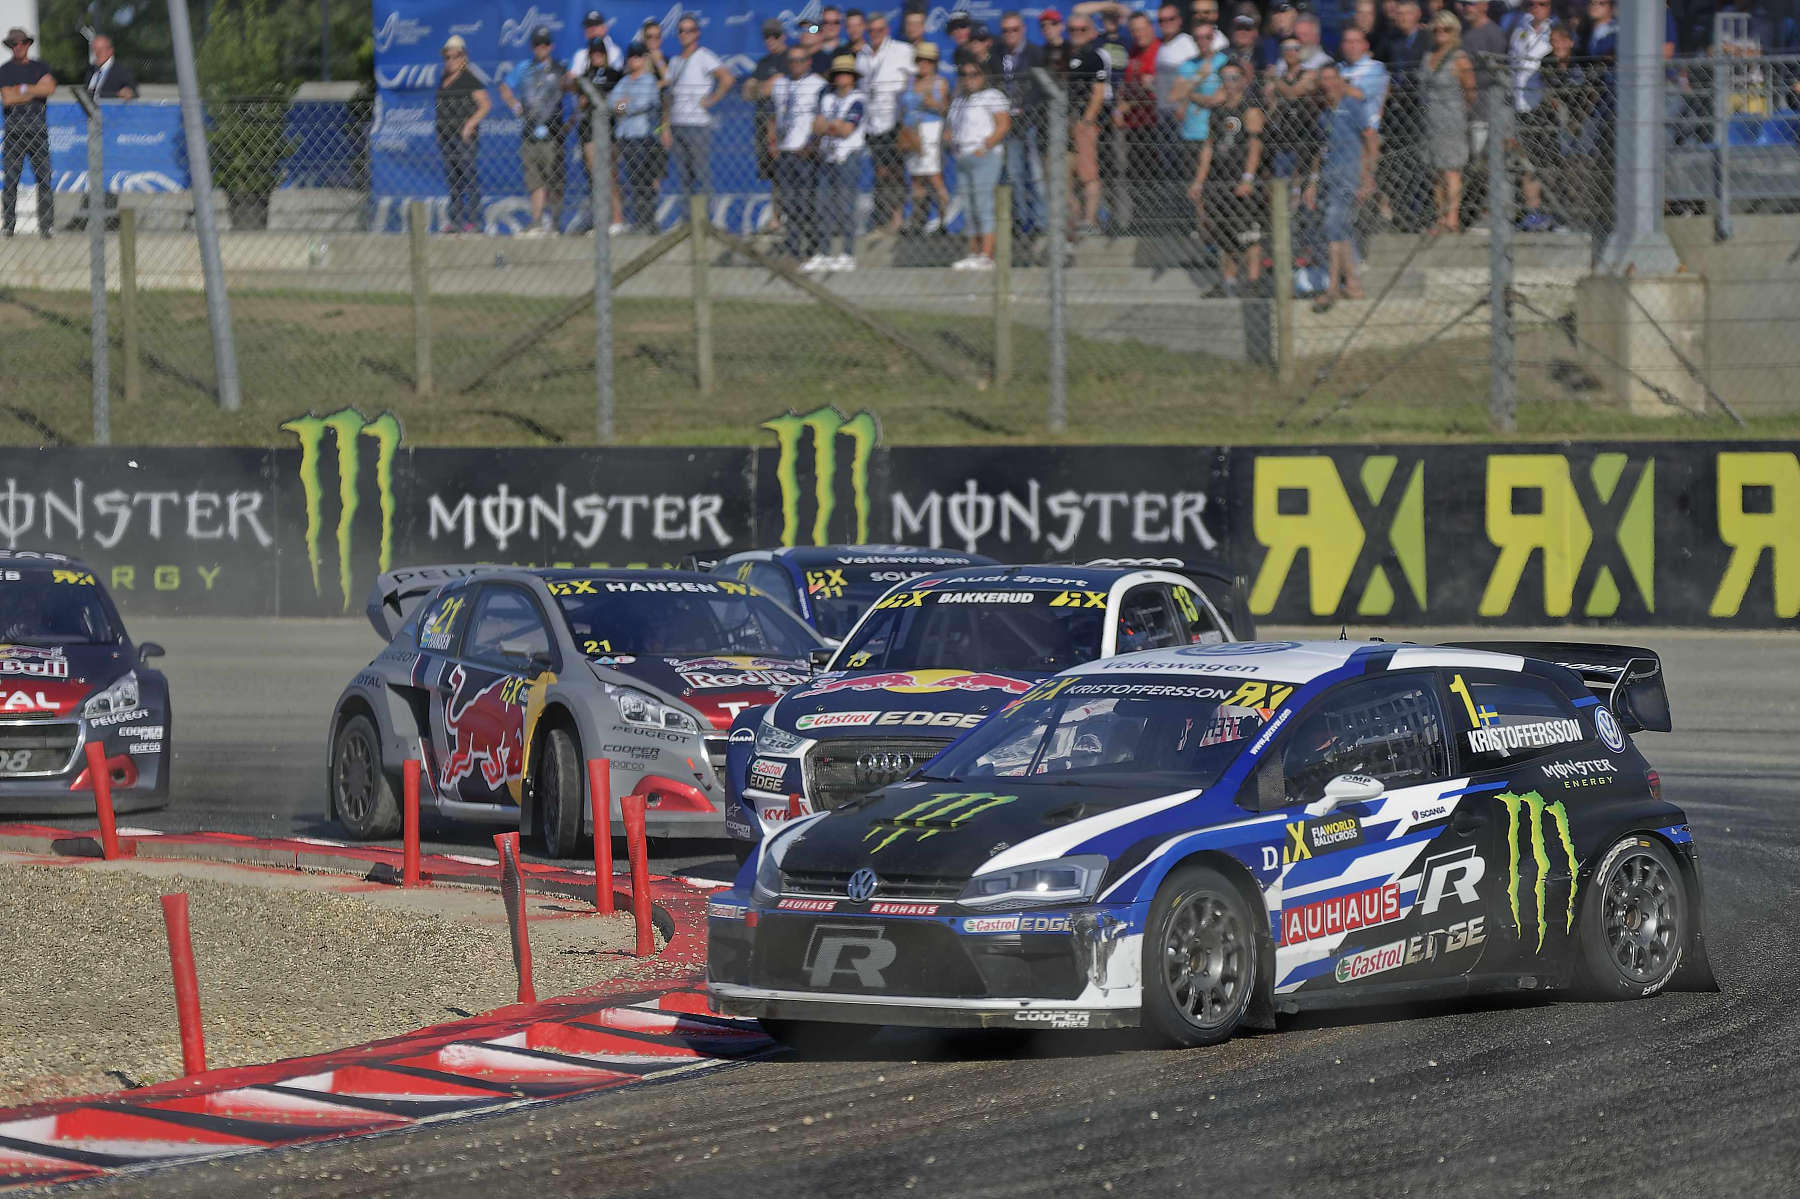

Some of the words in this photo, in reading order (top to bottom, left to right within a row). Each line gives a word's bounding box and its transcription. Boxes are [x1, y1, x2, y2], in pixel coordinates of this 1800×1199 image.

[427, 483, 733, 551] MONSTER
[891, 478, 1218, 553] MONSTER
[1248, 455, 1427, 616] RX
[1478, 453, 1655, 618] RX
[837, 556, 970, 565] Volkswagen
[606, 582, 718, 593] HANSEN
[947, 575, 1008, 584] Audi
[1013, 575, 1089, 587] Sport
[937, 592, 1034, 604] BAKKERUD
[583, 640, 611, 653] 21
[1102, 660, 1259, 673] Volkswagen
[680, 670, 765, 689] Red
[1064, 684, 1232, 701] KRISTOFFERSSON
[1222, 681, 1293, 711] RX
[1449, 673, 1482, 729] 1
[90, 709, 149, 728] PEUGEOT
[814, 711, 872, 728] Castrol
[876, 711, 986, 729] EDGE
[119, 726, 163, 738] COOPER
[612, 725, 690, 744] PEUGEOT
[1467, 719, 1583, 757] KRISTOFFERSSON
[603, 744, 661, 757] COOPER
[757, 761, 784, 777] Castrol
[1541, 758, 1618, 780] MONSTER
[750, 774, 784, 792] EDGE
[1564, 776, 1614, 789] ENERGY
[1420, 806, 1447, 819] SCANIA
[1313, 829, 1358, 847] RALLYCROSS
[1415, 845, 1486, 916] R
[777, 900, 837, 911] BAUHAUS
[871, 904, 938, 915] BAUHAUS
[976, 919, 1016, 931] Castrol
[803, 924, 897, 988] R
[1351, 943, 1403, 978] Castrol
[1014, 1010, 1090, 1021] COOPER
[1050, 1019, 1089, 1028] TIRES
